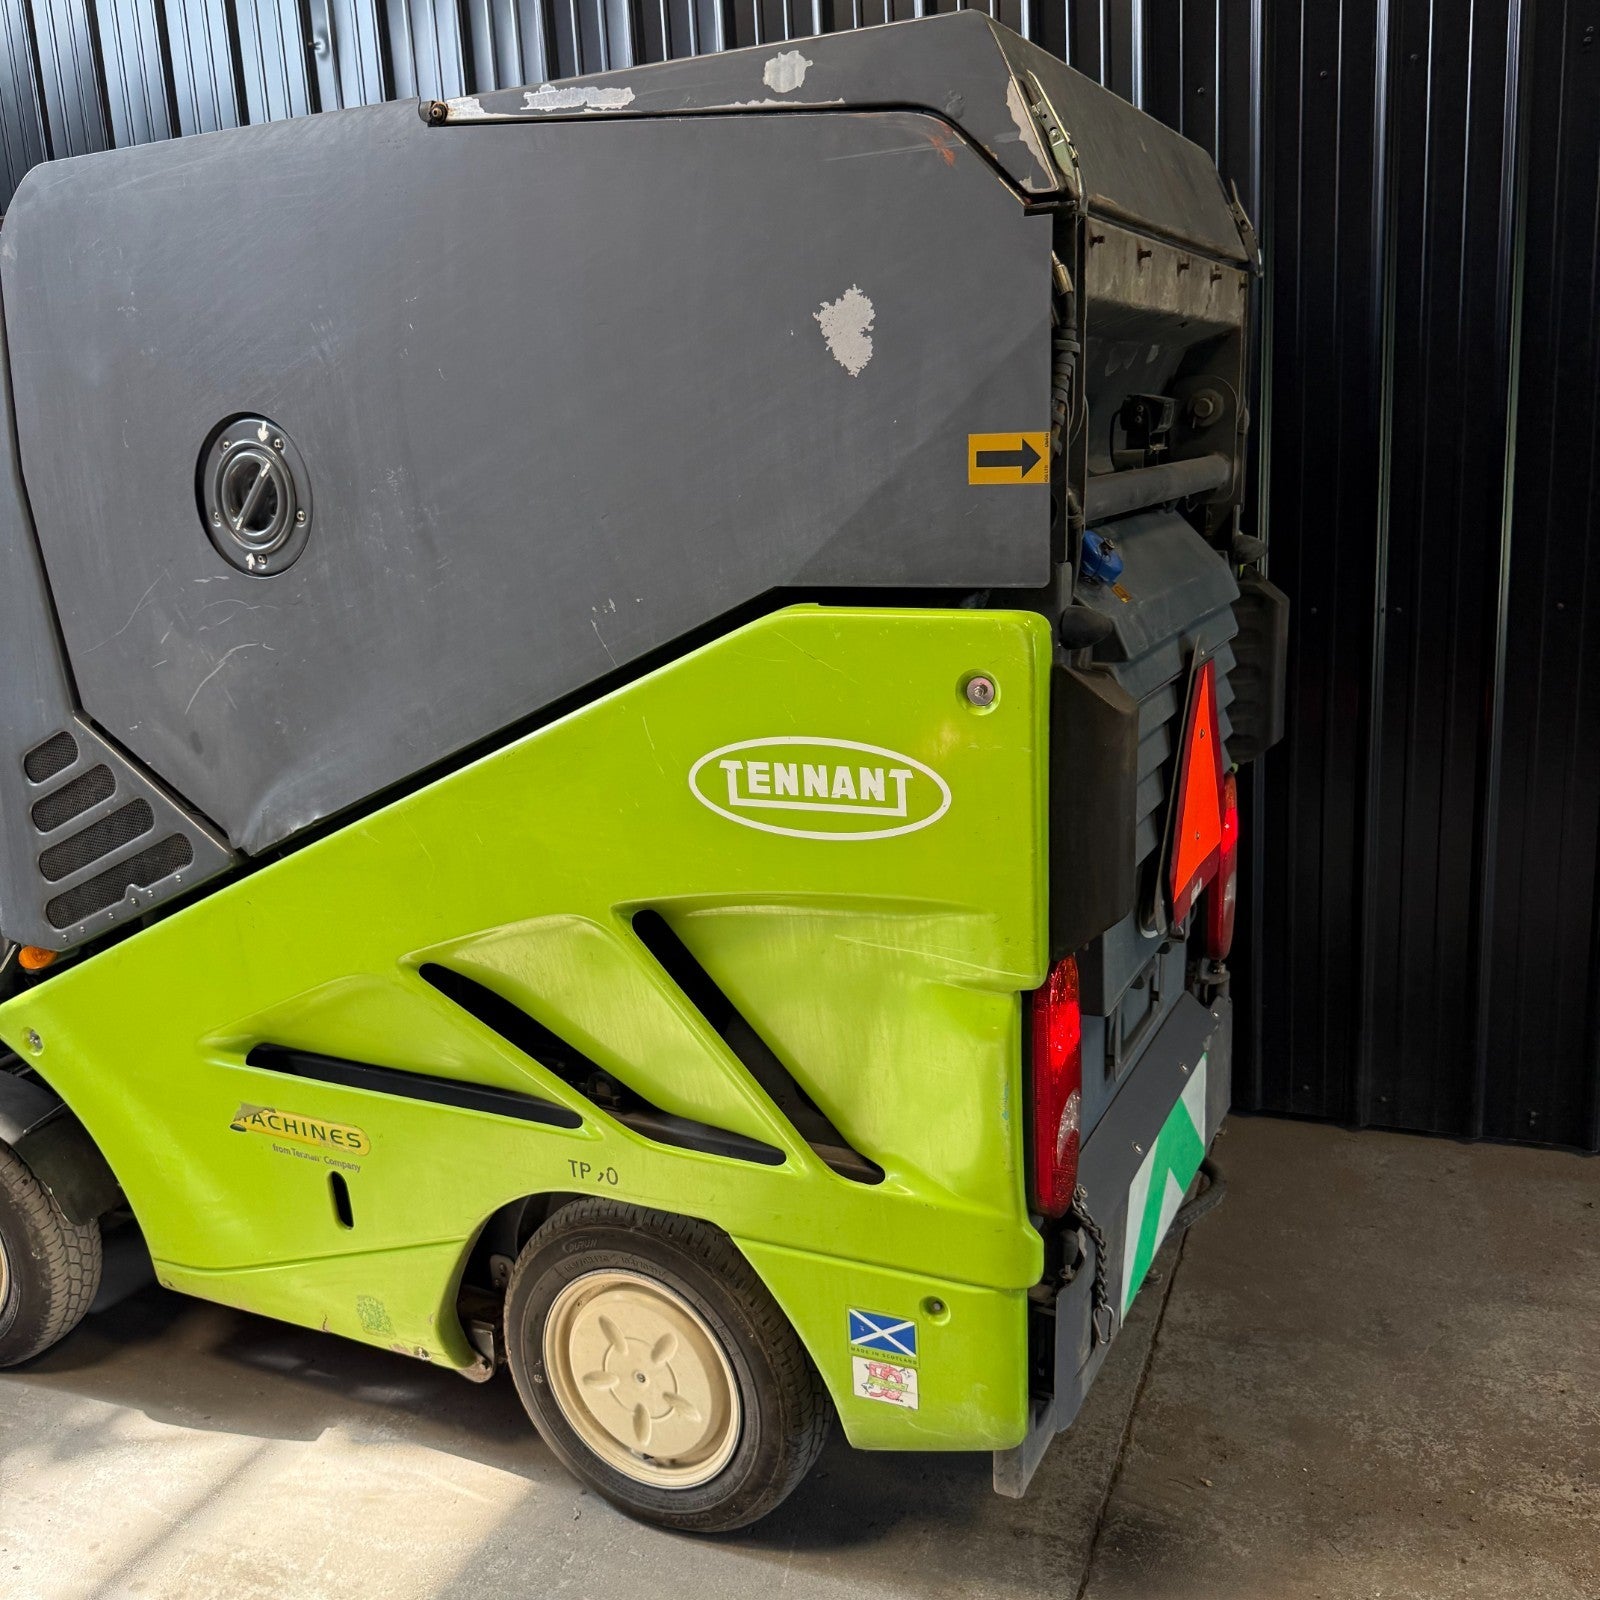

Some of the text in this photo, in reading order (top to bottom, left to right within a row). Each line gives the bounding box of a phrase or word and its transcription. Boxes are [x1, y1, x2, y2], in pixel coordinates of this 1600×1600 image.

[719, 760, 914, 817] TENNANT
[243, 1112, 362, 1149] ACHINES
[323, 1156, 361, 1173] Company
[850, 1347, 869, 1355] MADE
[882, 1353, 917, 1365] SCOTLAND
